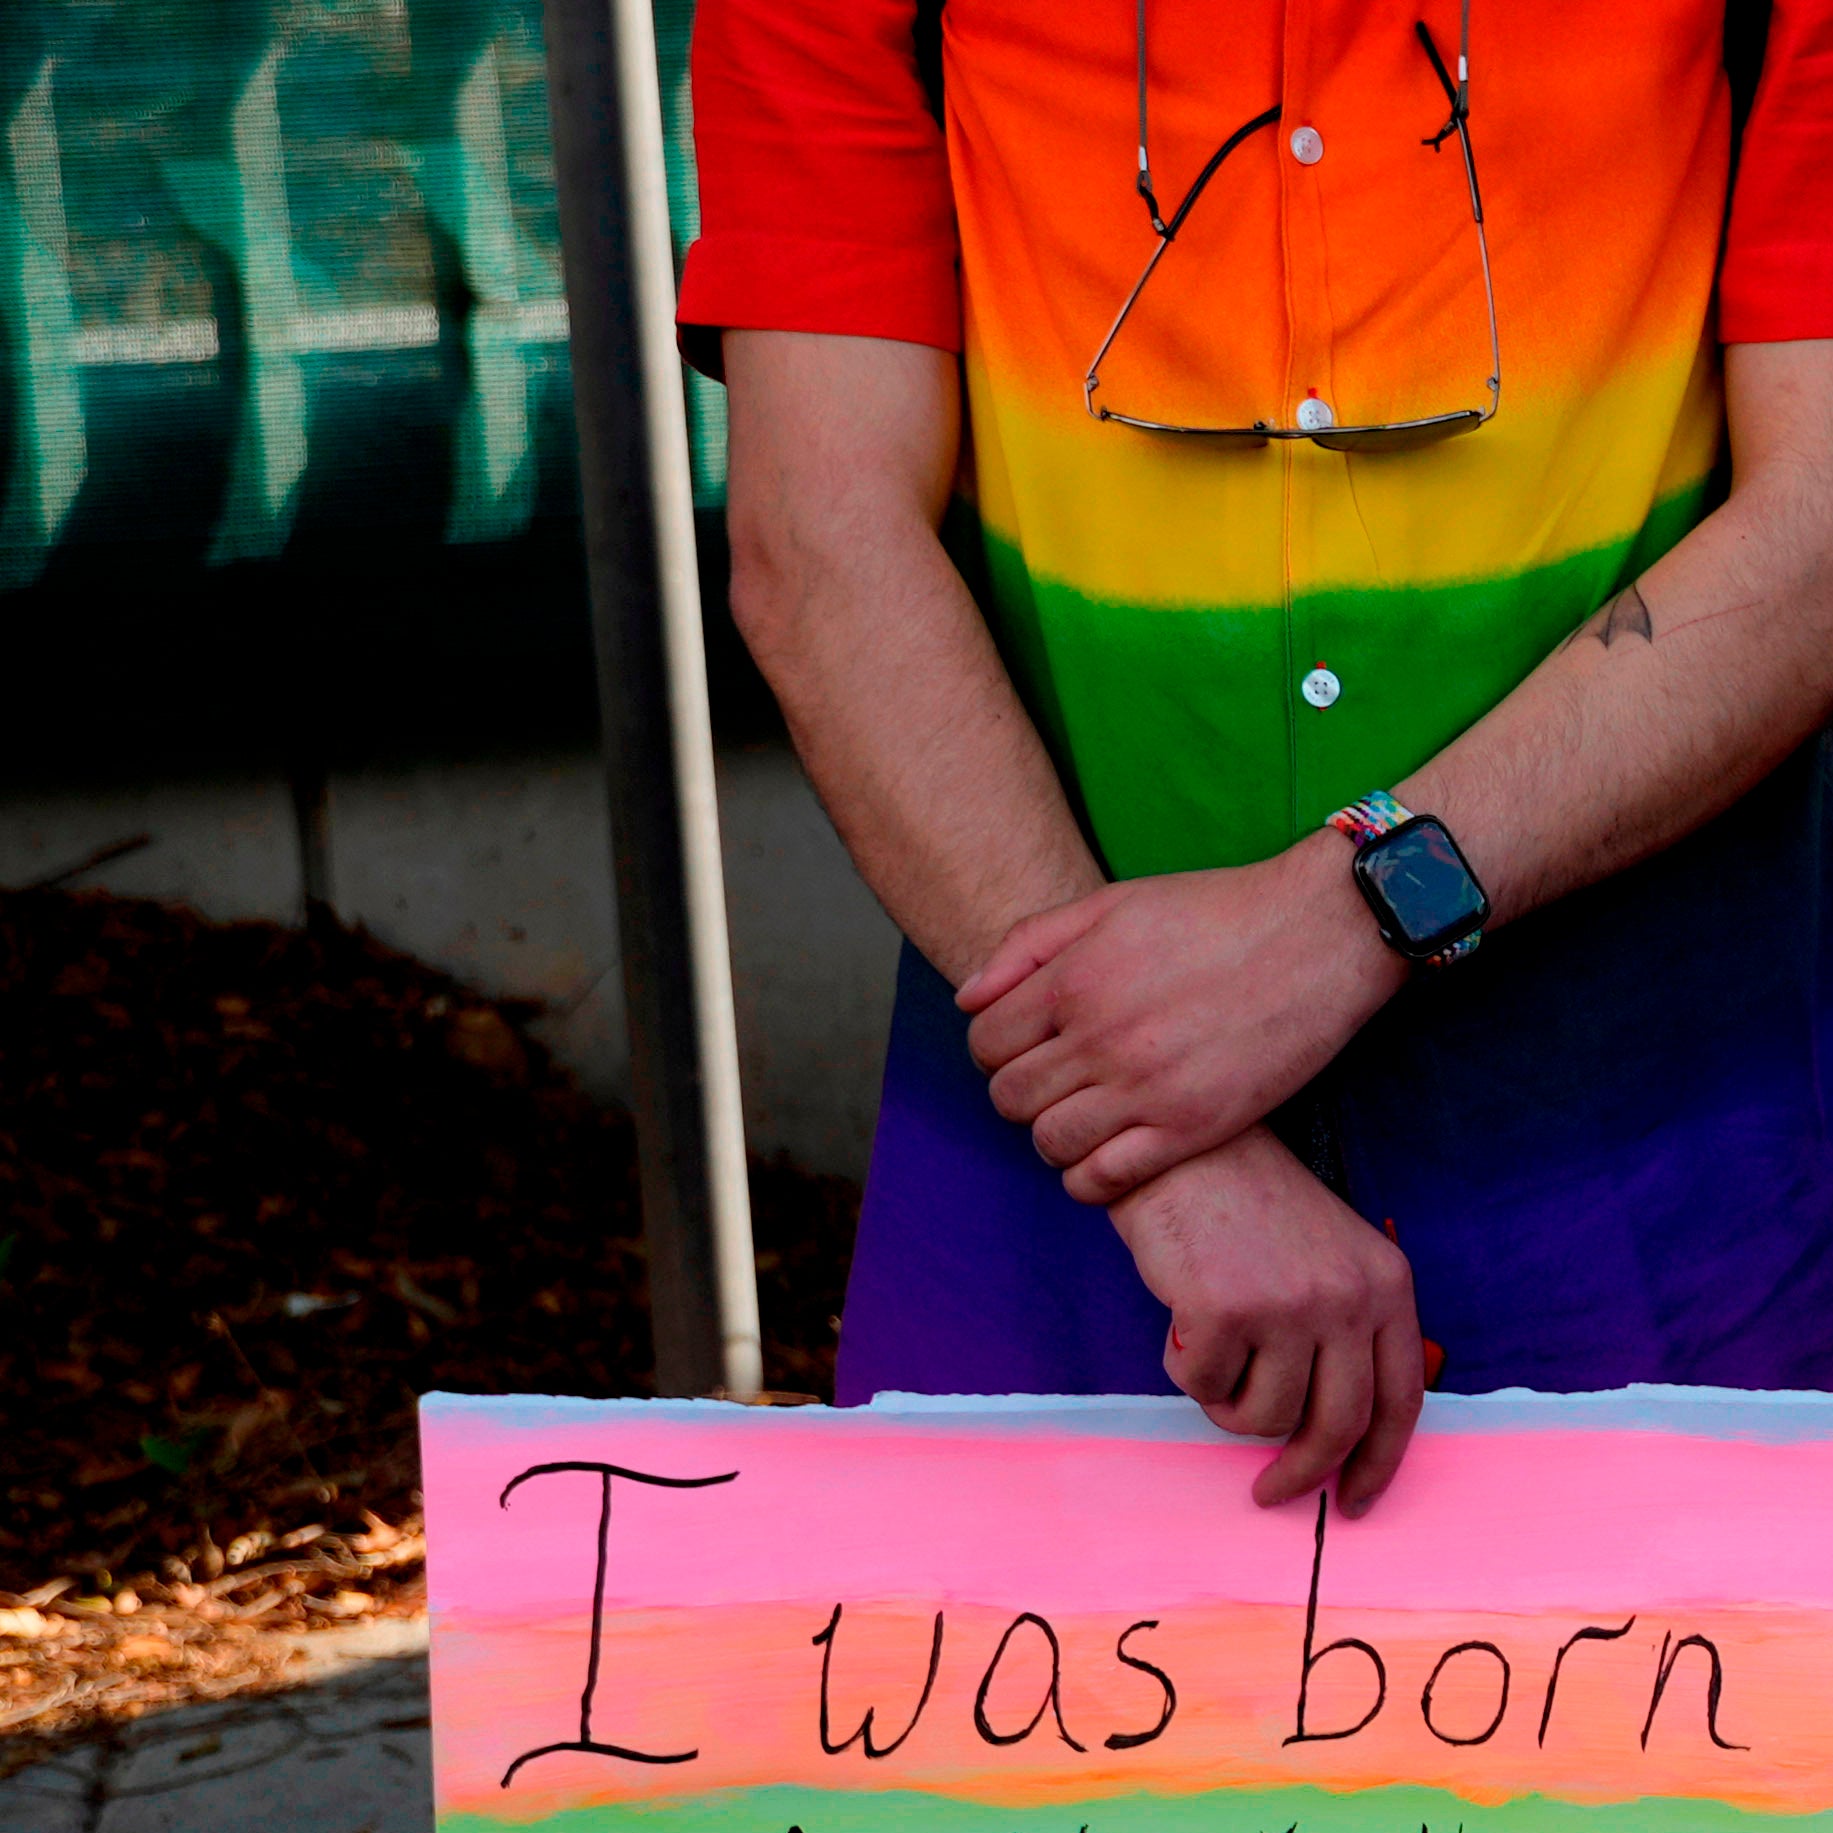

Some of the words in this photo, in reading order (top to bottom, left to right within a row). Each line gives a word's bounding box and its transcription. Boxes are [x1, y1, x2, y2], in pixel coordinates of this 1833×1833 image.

[500, 1460, 740, 1788] I
[811, 1603, 1176, 1758] was
[1282, 1488, 1751, 1753] born
